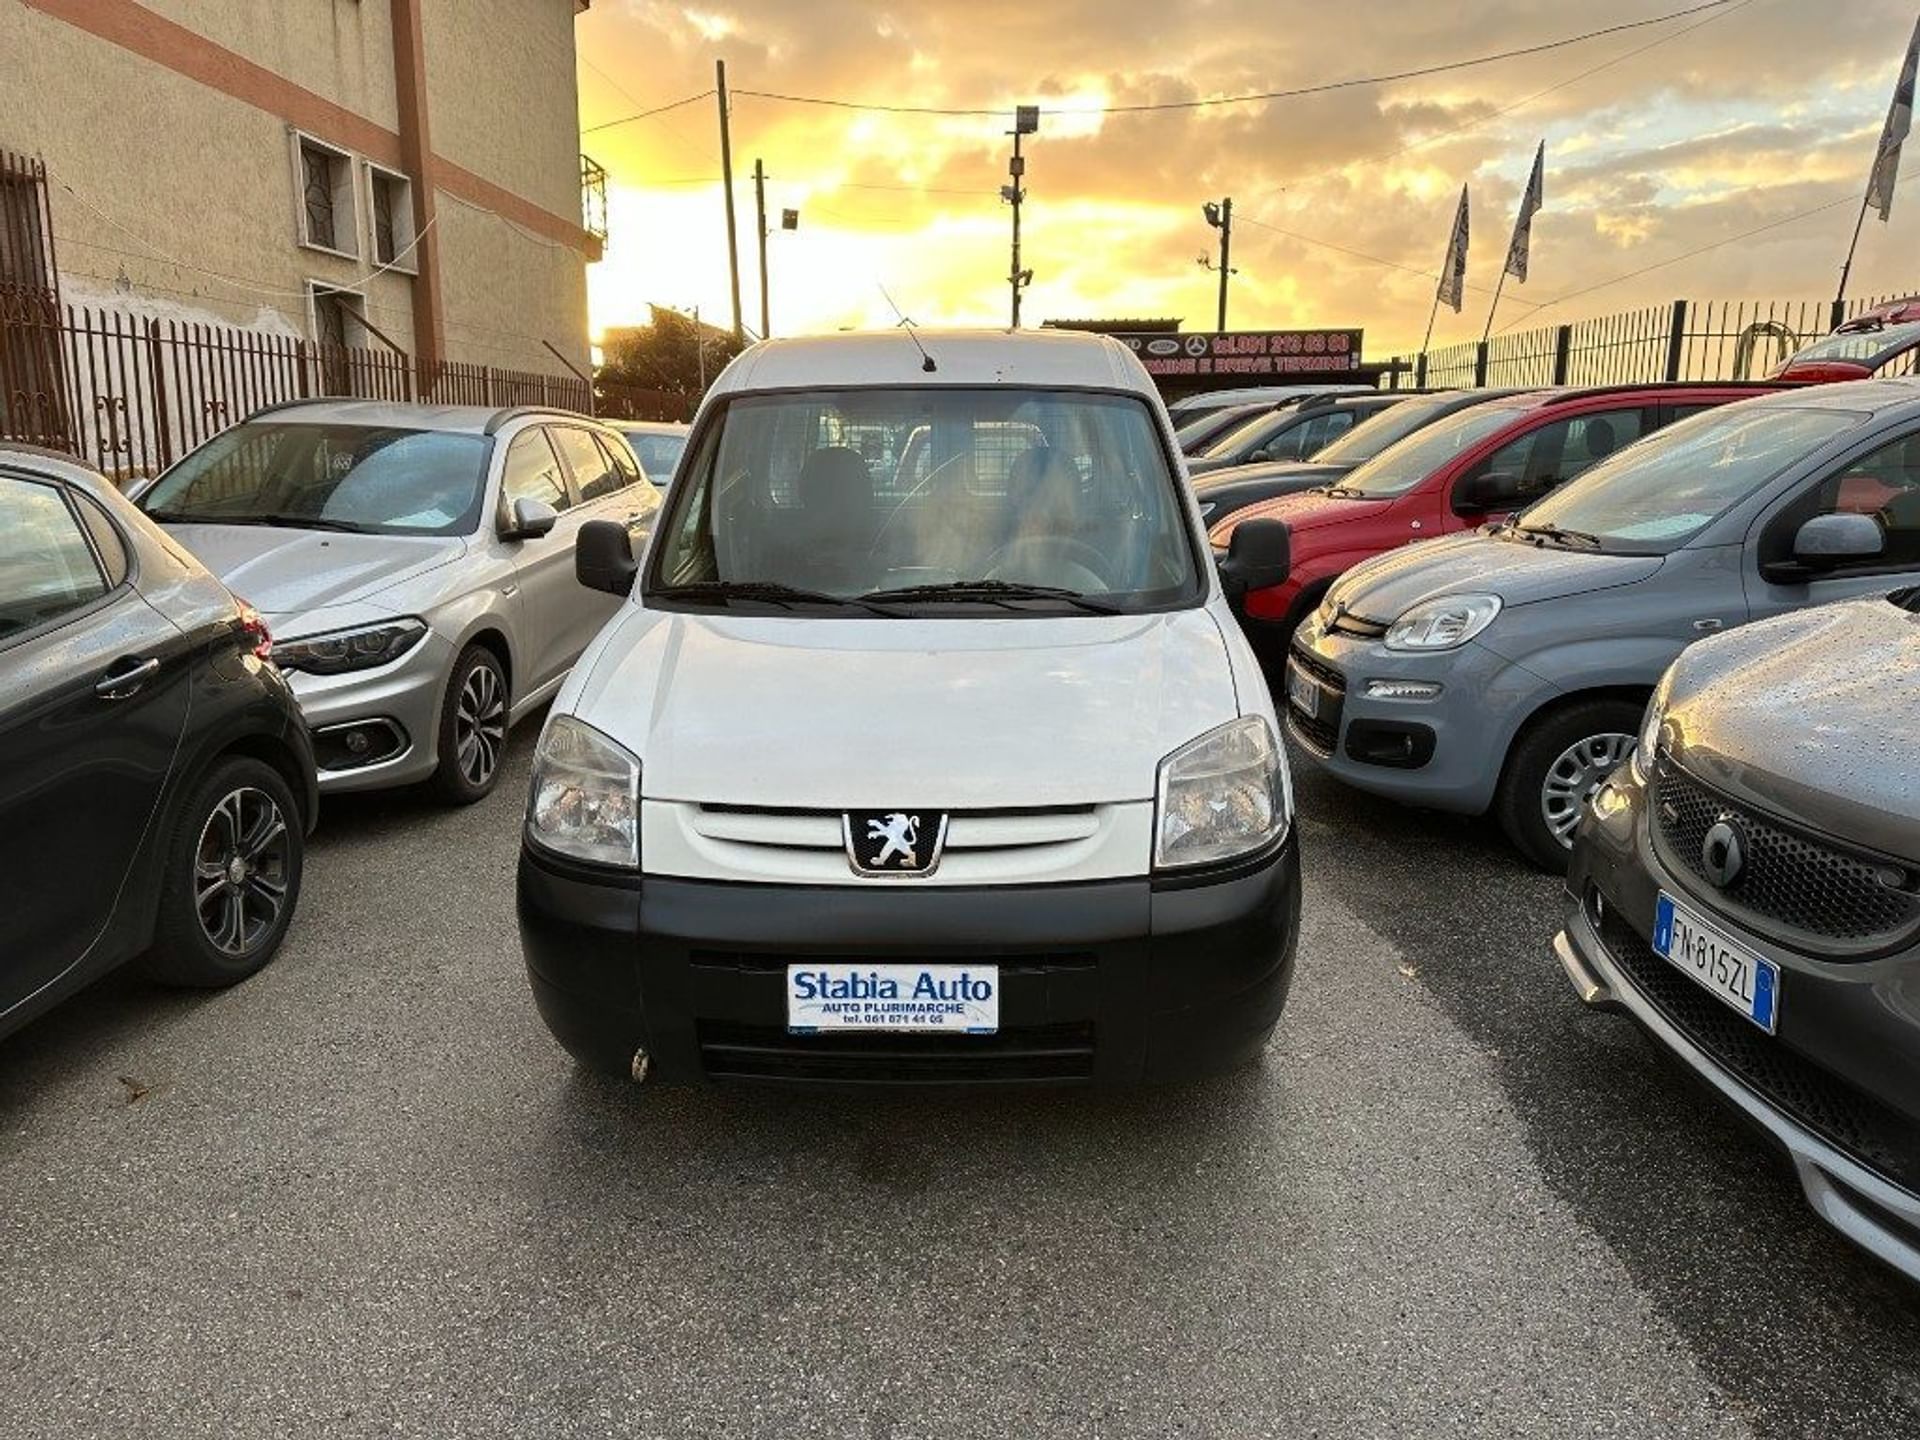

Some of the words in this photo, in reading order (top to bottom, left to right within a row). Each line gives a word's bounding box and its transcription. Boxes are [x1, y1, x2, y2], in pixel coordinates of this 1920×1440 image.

[1214, 358, 1272, 373] BREVE
[1274, 356, 1349, 371] TERMINE
[794, 971, 898, 1000] Stabia
[912, 972, 993, 1001] Auto
[822, 1003, 861, 1013] AUTO
[864, 1003, 965, 1014] PLURIMARCHE
